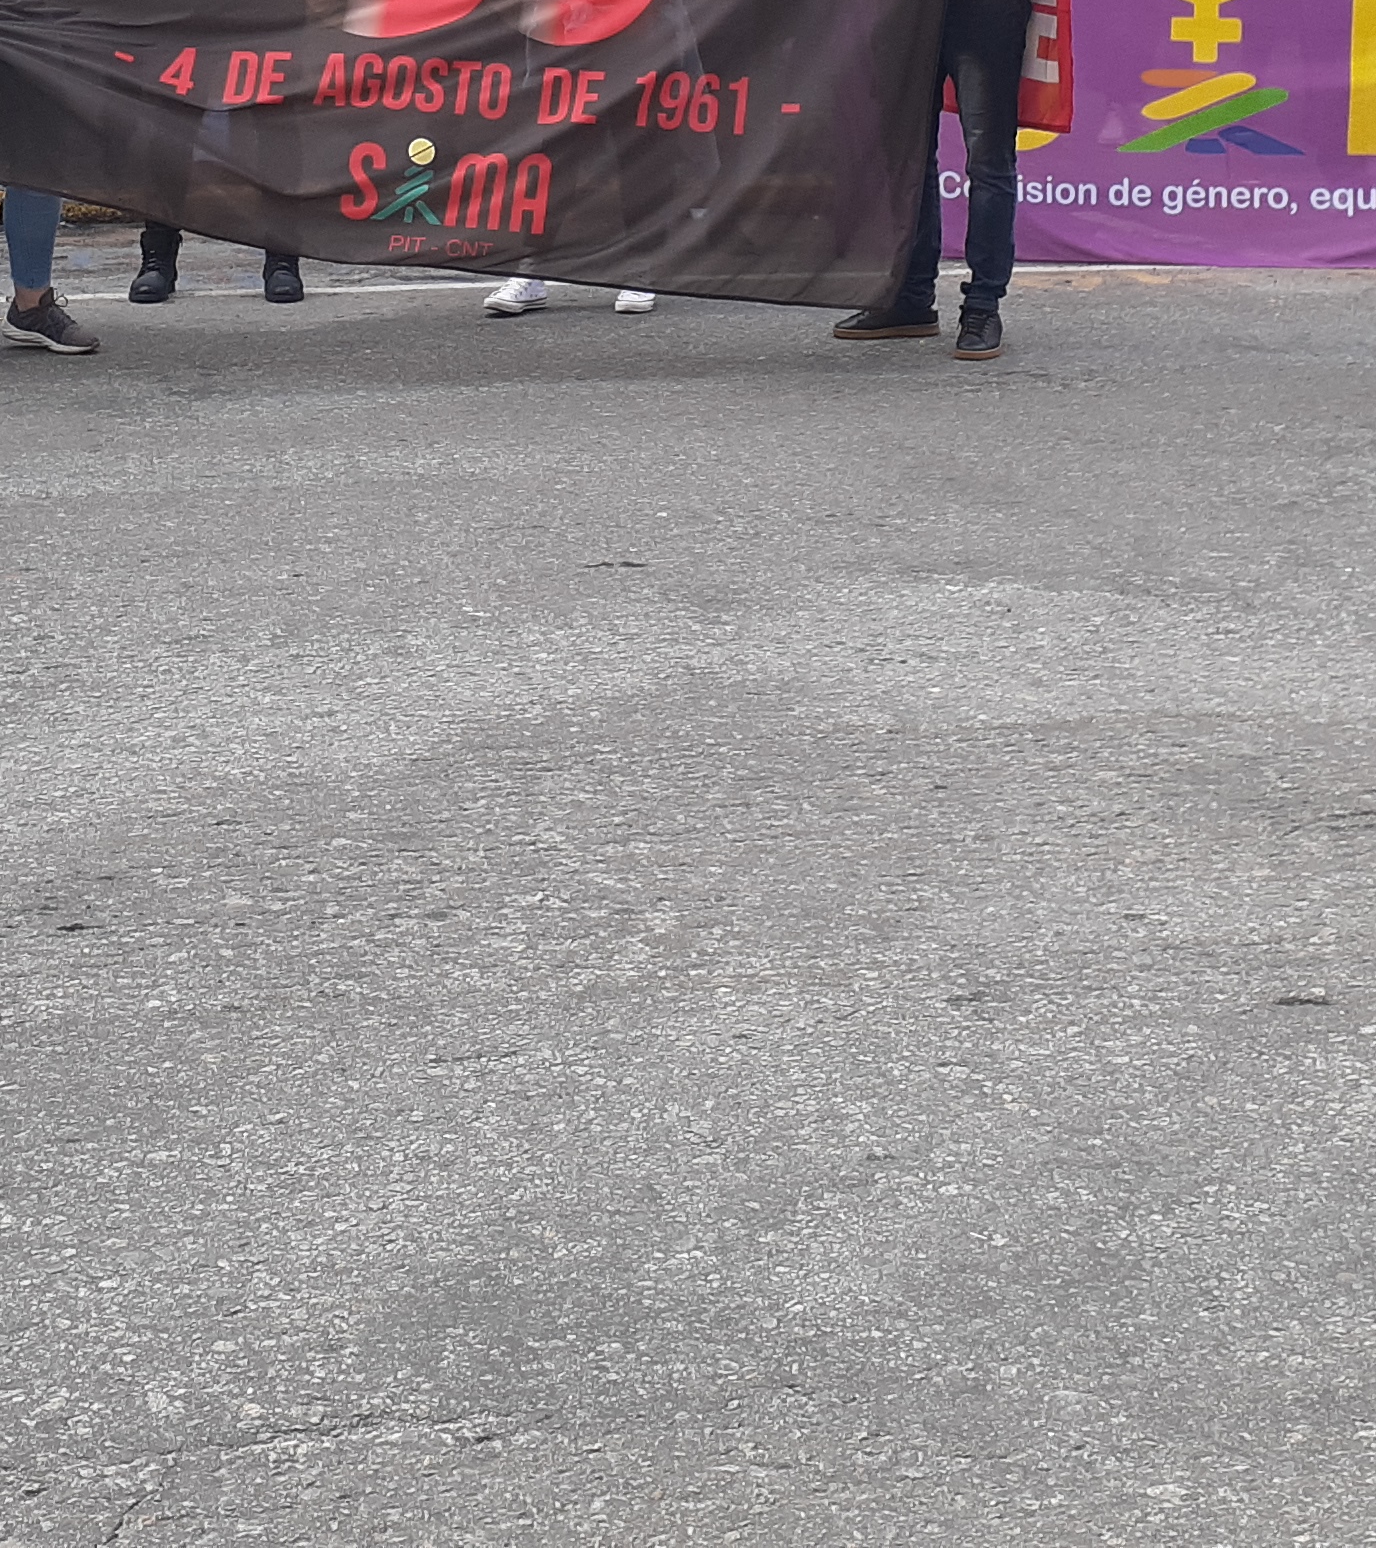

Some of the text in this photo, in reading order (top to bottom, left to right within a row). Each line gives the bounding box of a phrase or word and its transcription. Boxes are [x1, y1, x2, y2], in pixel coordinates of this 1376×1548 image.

[160, 47, 197, 95] 4
[222, 50, 293, 105] DE
[313, 52, 512, 121] AGOSTO
[536, 67, 607, 126] DE
[634, 70, 750, 136] 1961
[938, 170, 1098, 206] Cision
[1108, 177, 1152, 207] de
[1162, 179, 1299, 215] género,
[388, 235, 427, 253] PIT
[445, 238, 494, 257] CNT
